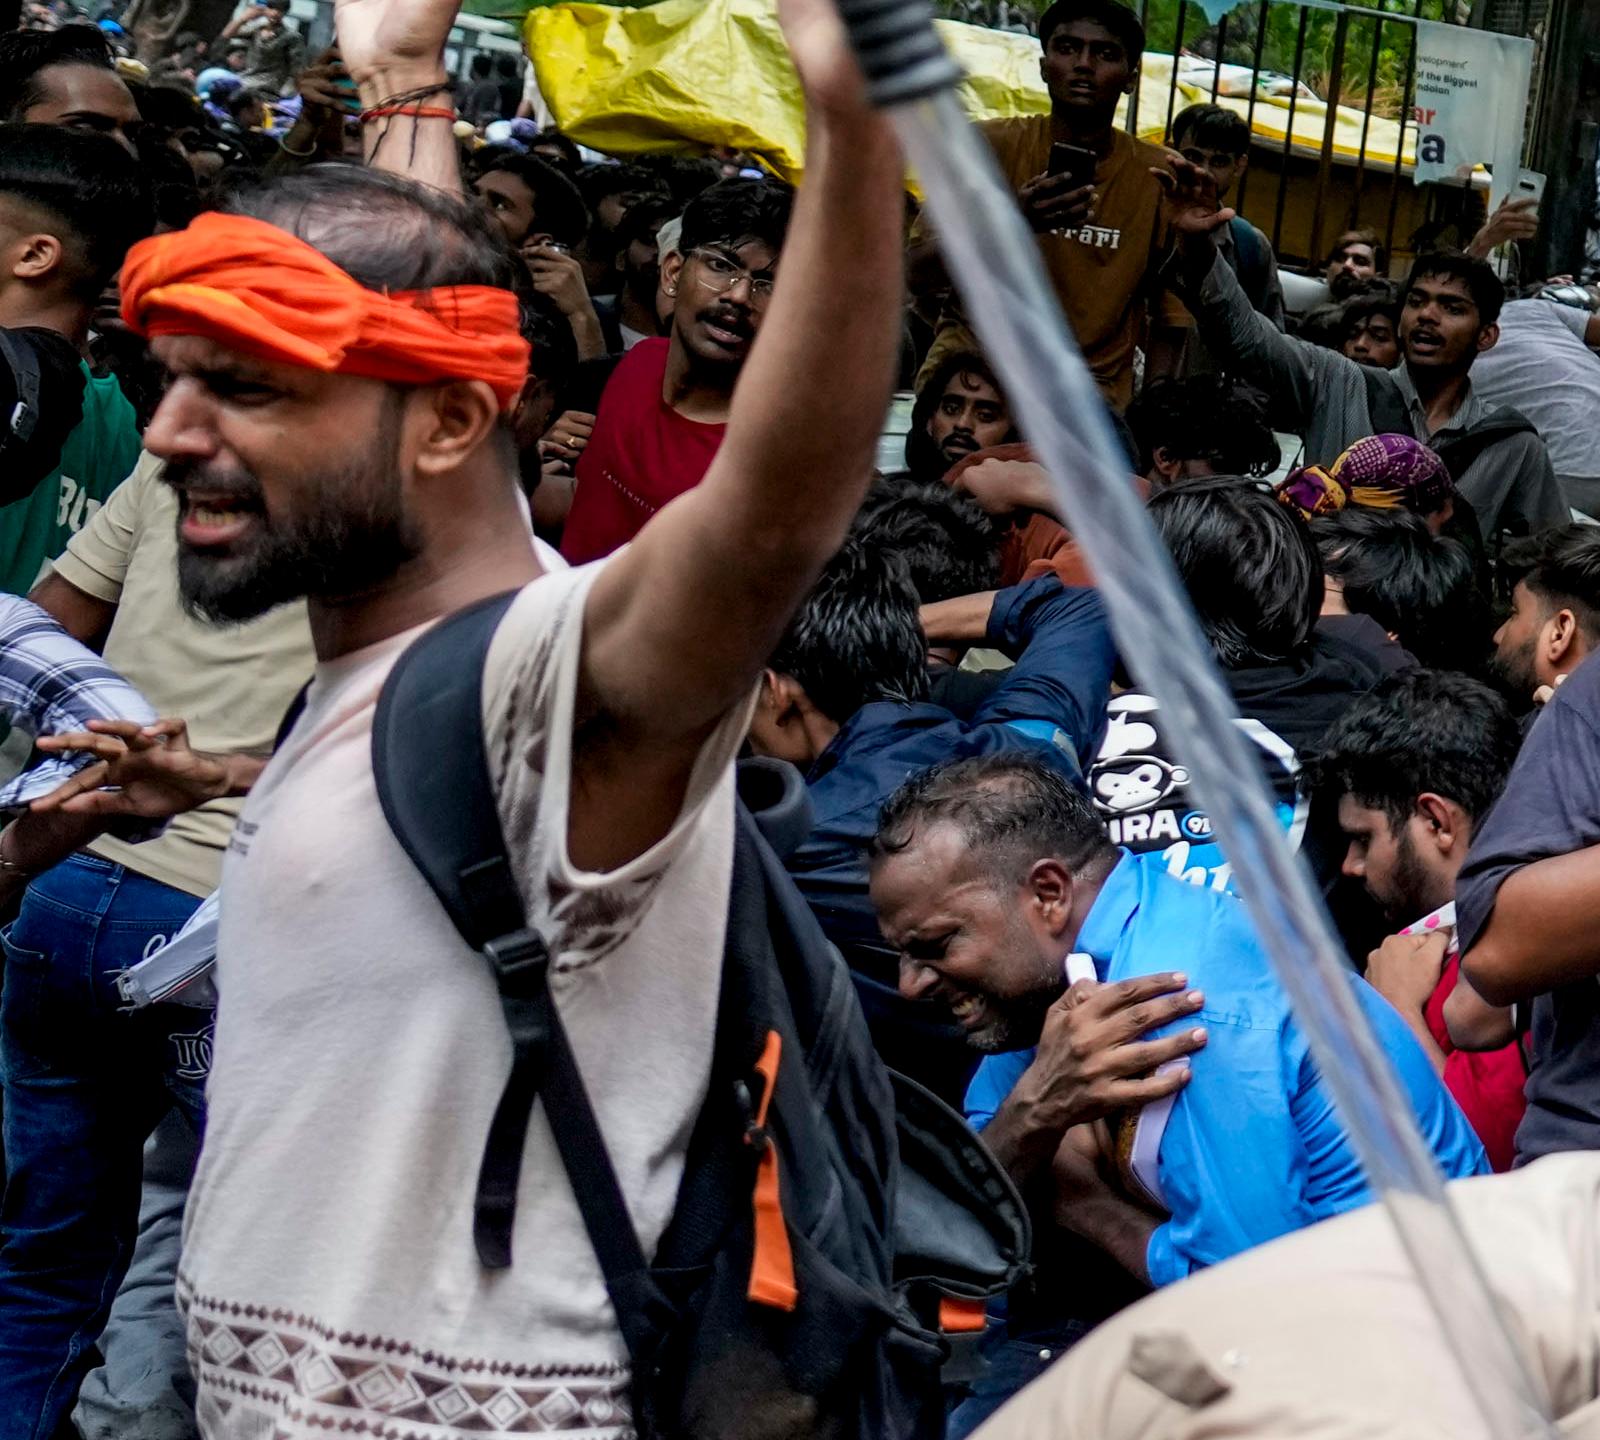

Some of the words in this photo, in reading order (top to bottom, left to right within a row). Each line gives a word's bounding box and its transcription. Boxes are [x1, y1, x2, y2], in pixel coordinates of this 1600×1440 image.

[1417, 83, 1450, 95] ndolan
[1427, 72, 1441, 81] the
[1443, 75, 1478, 88] Biggest
[1414, 106, 1436, 126] ar
[1421, 134, 1446, 164] a
[1049, 225, 1120, 249] rari
